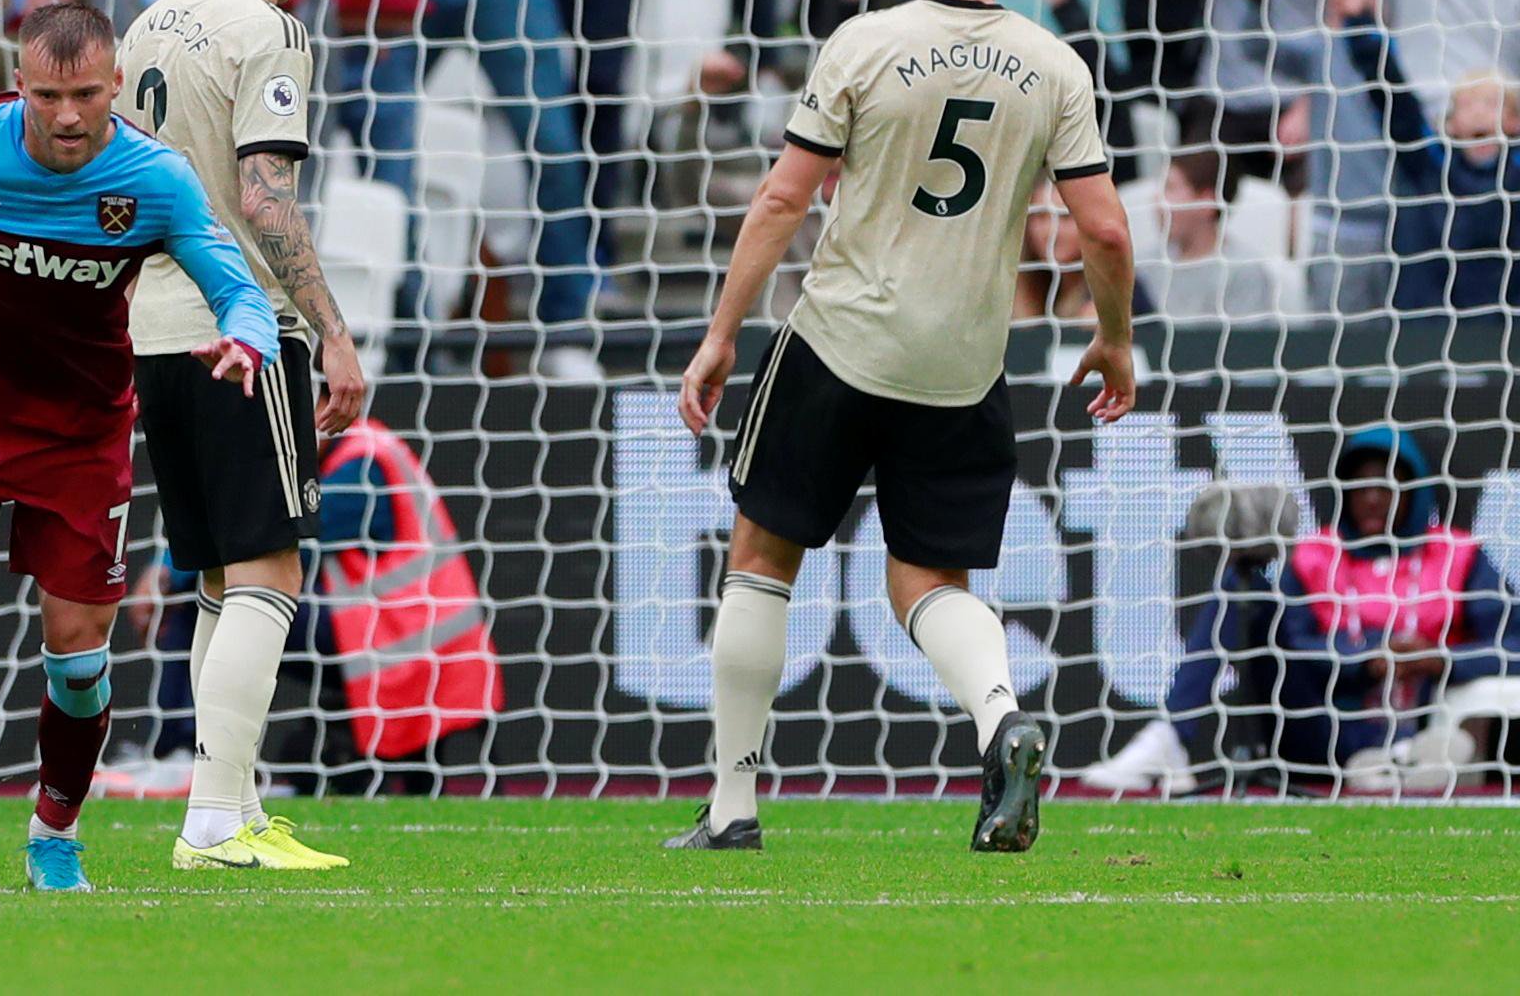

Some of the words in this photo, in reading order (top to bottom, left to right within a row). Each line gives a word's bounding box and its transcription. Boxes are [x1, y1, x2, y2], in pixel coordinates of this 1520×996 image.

[896, 44, 1041, 96] MAGUIRE
[912, 98, 997, 218] 5
[108, 501, 130, 564] 7
